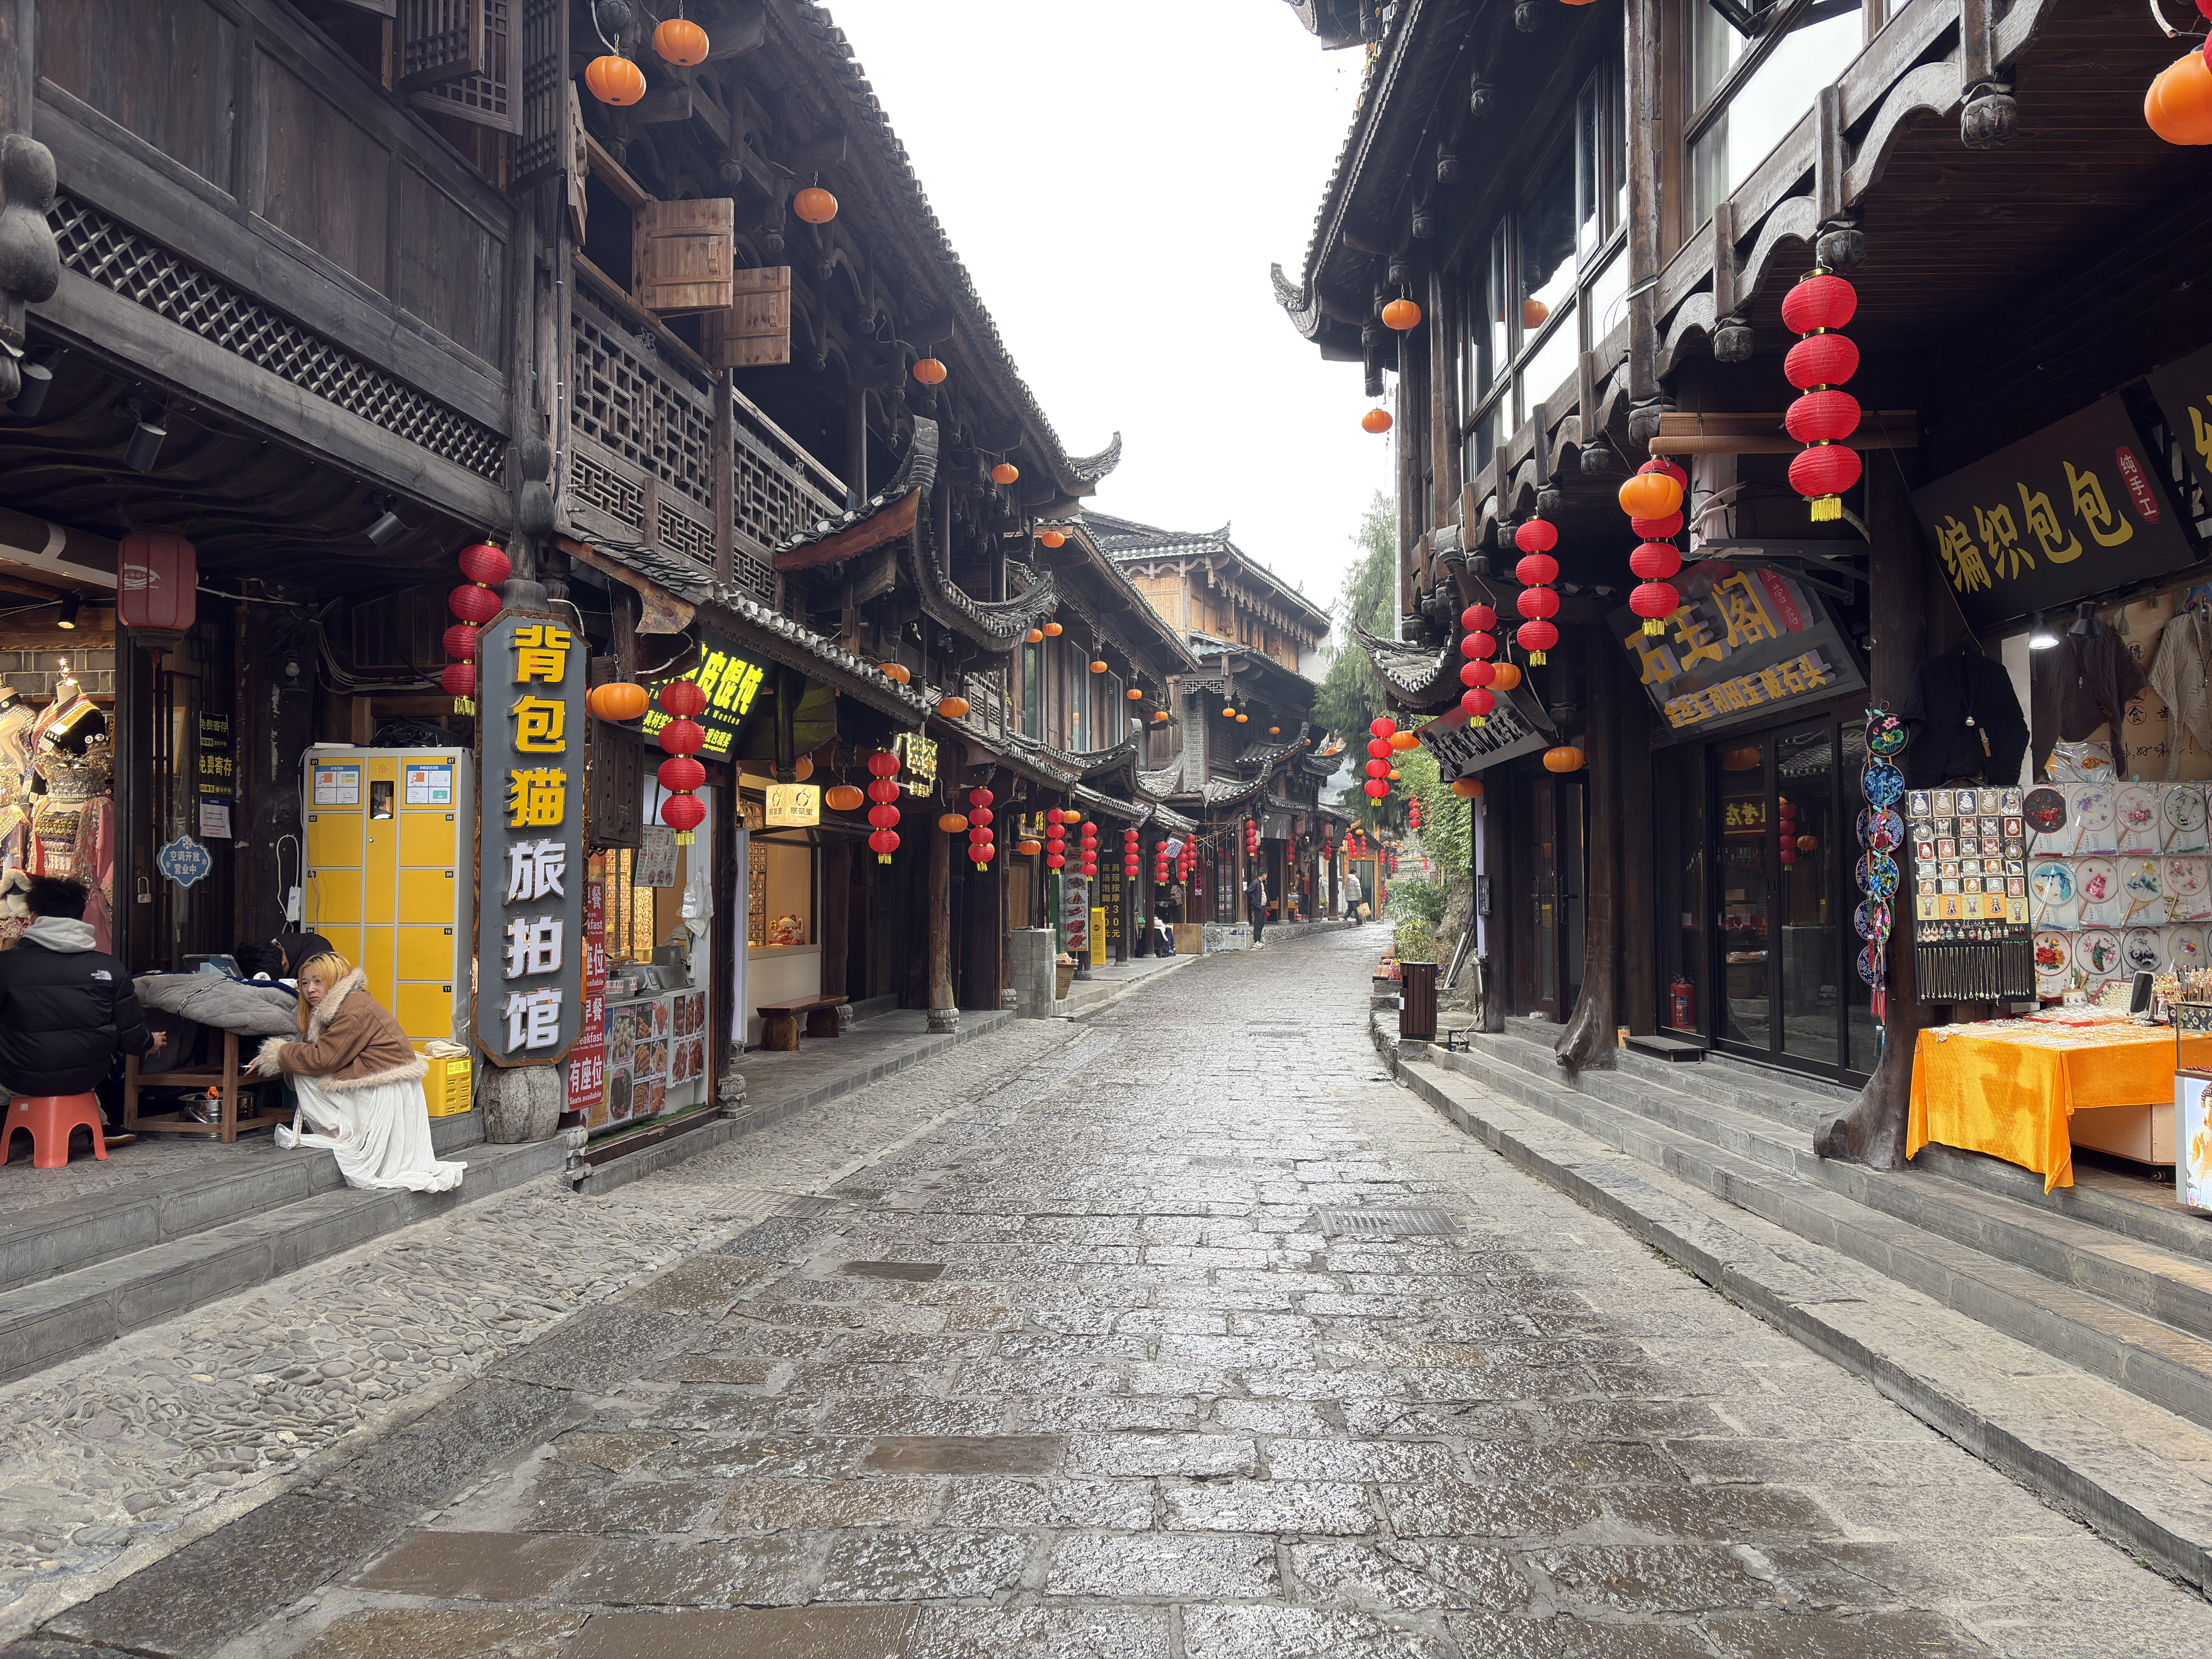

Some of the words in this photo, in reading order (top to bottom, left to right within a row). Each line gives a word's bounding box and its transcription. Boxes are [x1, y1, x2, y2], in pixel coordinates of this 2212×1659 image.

[2120, 454, 2157, 517] 纯手工
[1935, 460, 2133, 594] 编织包包
[1625, 571, 1777, 684] 石玉阁
[200, 719, 228, 733] 免费寄存
[712, 709, 740, 726] Wonton
[705, 728, 732, 748] 现包现卖
[199, 754, 232, 776] 免费寄存
[790, 807, 813, 816] 翠茶里
[506, 625, 571, 1051] 背包猫旅拍馆
[170, 851, 200, 862] 空调开放
[174, 863, 197, 875] 营业中
[1112, 864, 1120, 938] 肩颈按摩30元
[587, 919, 603, 930] kfast
[587, 979, 603, 987] vailable
[577, 1032, 602, 1045] eakfast
[570, 1055, 603, 1094] 有座位
[569, 1094, 581, 1105] Seats
[582, 1091, 602, 1102] available
